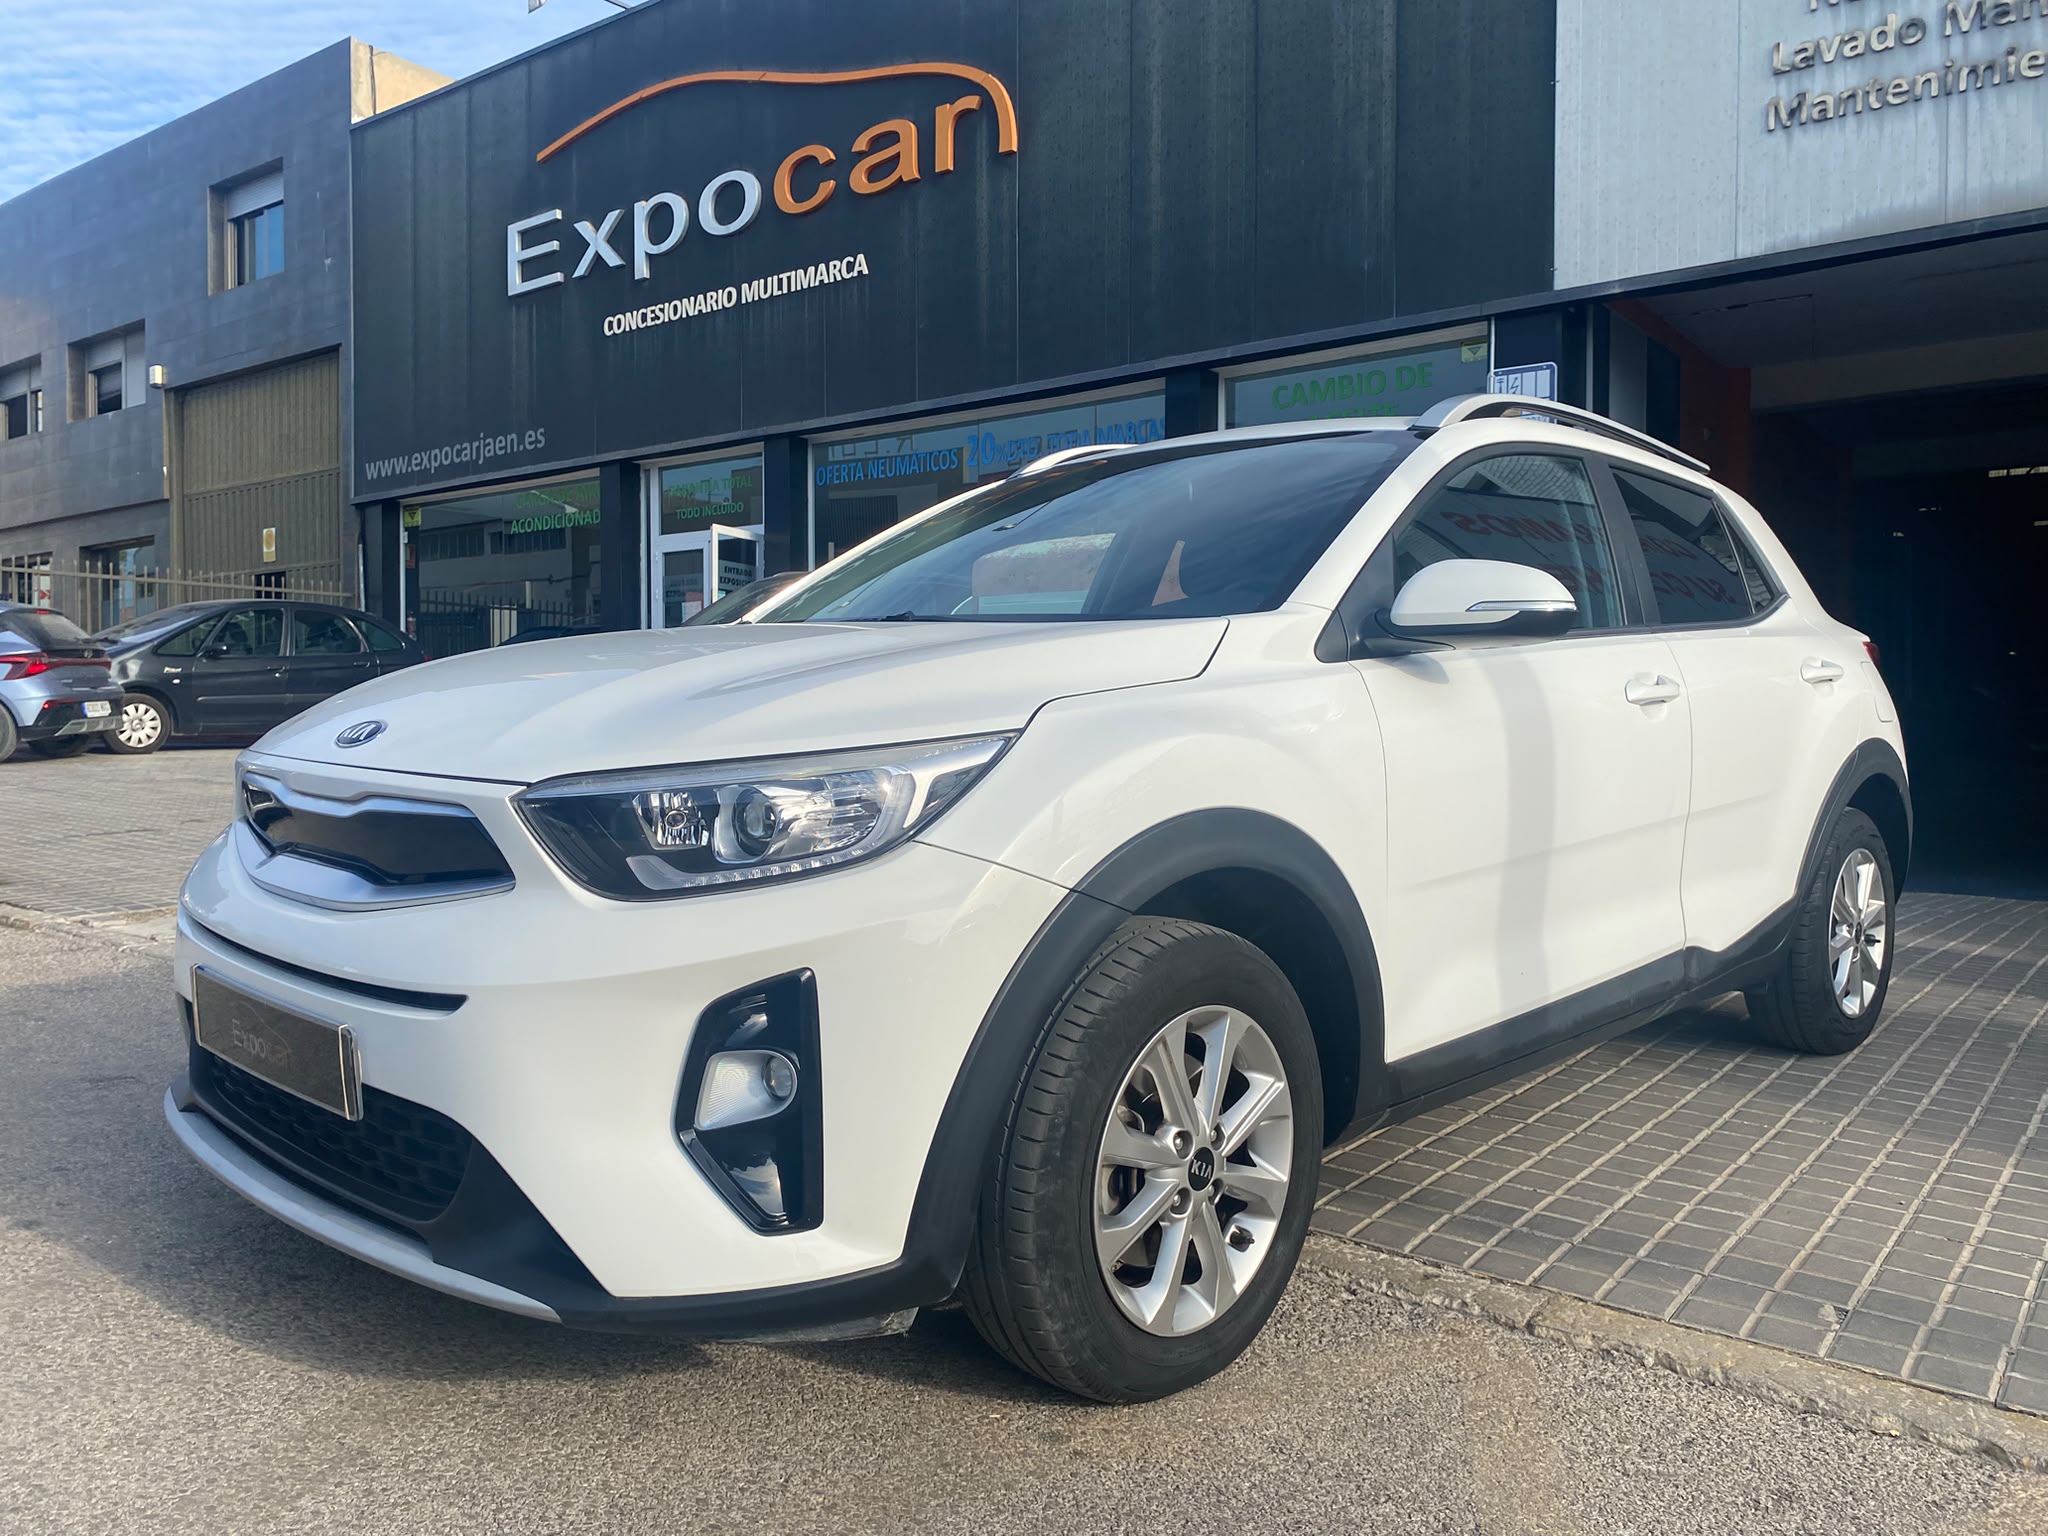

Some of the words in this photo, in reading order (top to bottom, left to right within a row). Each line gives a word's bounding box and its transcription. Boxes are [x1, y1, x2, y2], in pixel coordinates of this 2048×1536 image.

[1772, 13, 1927, 75] Lavado
[1766, 46, 2047, 132] Mantenimie
[506, 95, 983, 297] Expocar
[603, 286, 737, 336] CONCESIONARIO
[741, 253, 869, 304] MULTIMARCA
[1272, 369, 1386, 410] CAMBIO
[1395, 362, 1433, 392] DE
[366, 428, 546, 480] www.expocarjaen.es
[816, 462, 864, 486] OFERTA
[868, 447, 959, 480] NEUMÁTICOS
[721, 475, 752, 490] TOTAL
[675, 507, 700, 520] TODO
[724, 566, 753, 577] ENTRADA
[1191, 1159, 1212, 1179] KIA
